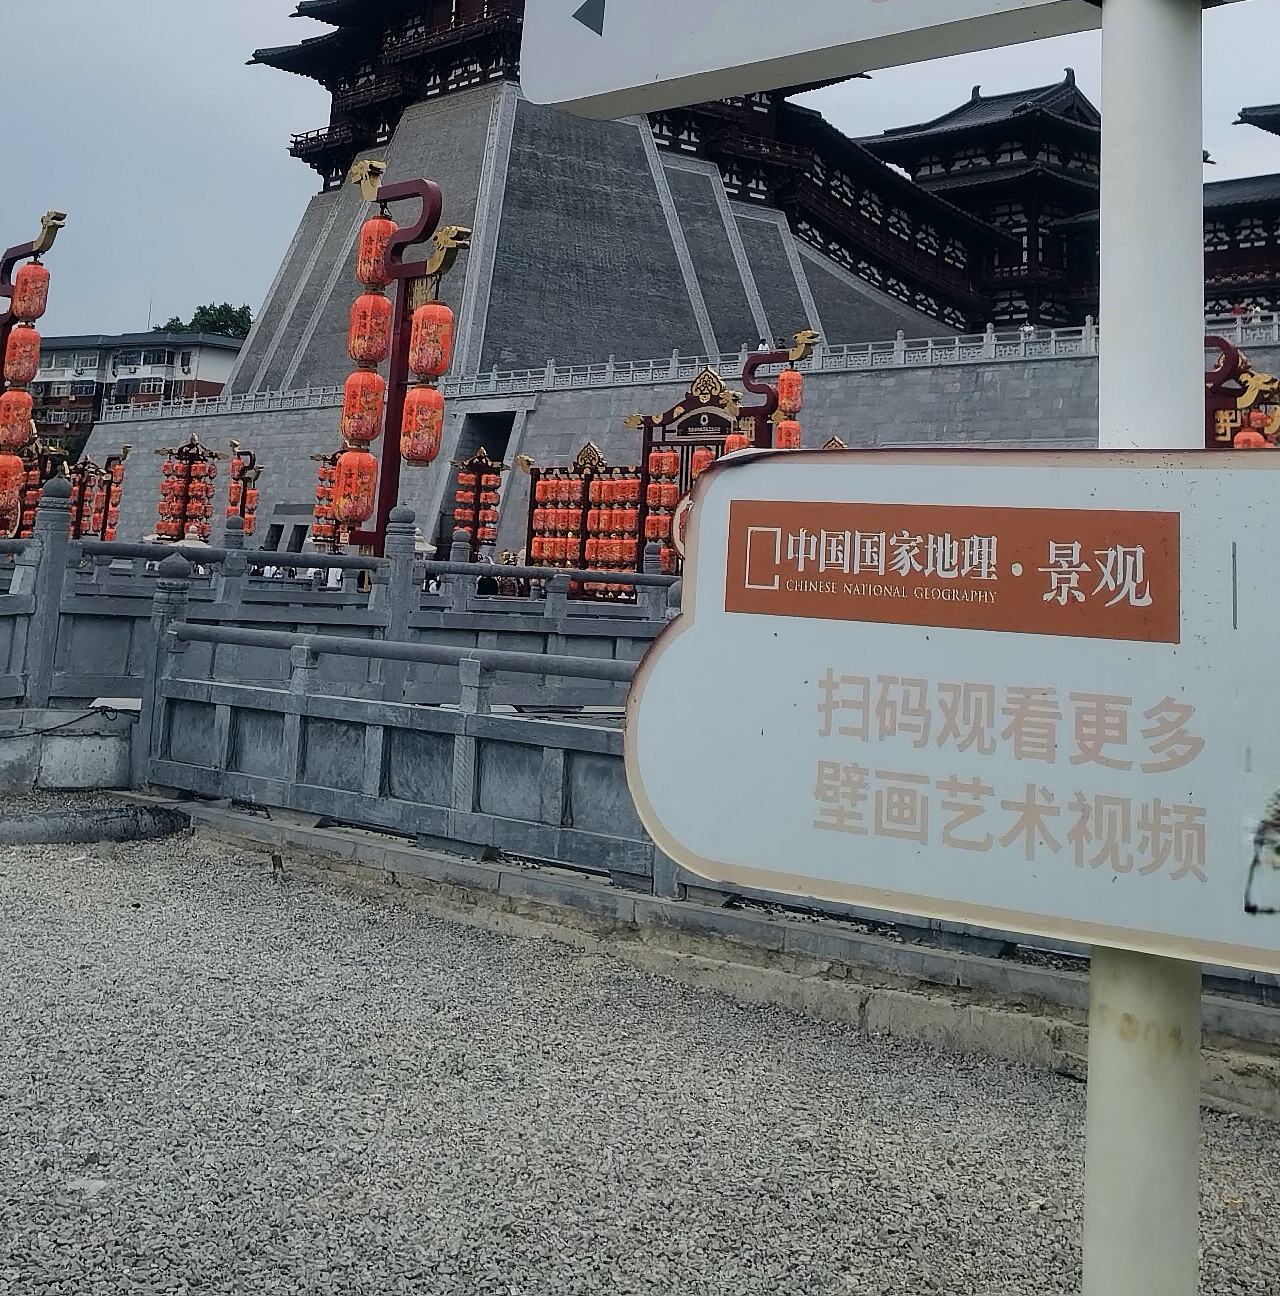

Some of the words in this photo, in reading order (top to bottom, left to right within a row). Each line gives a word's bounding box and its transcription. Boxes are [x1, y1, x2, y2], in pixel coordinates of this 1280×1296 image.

[786, 579, 837, 594] CHINESE
[843, 582, 908, 599] NATIONAL
[913, 586, 998, 604] GEOGRAPHY
[817, 667, 1206, 774] 扫码观看更多
[813, 759, 1209, 883] 壁画艺术视频
